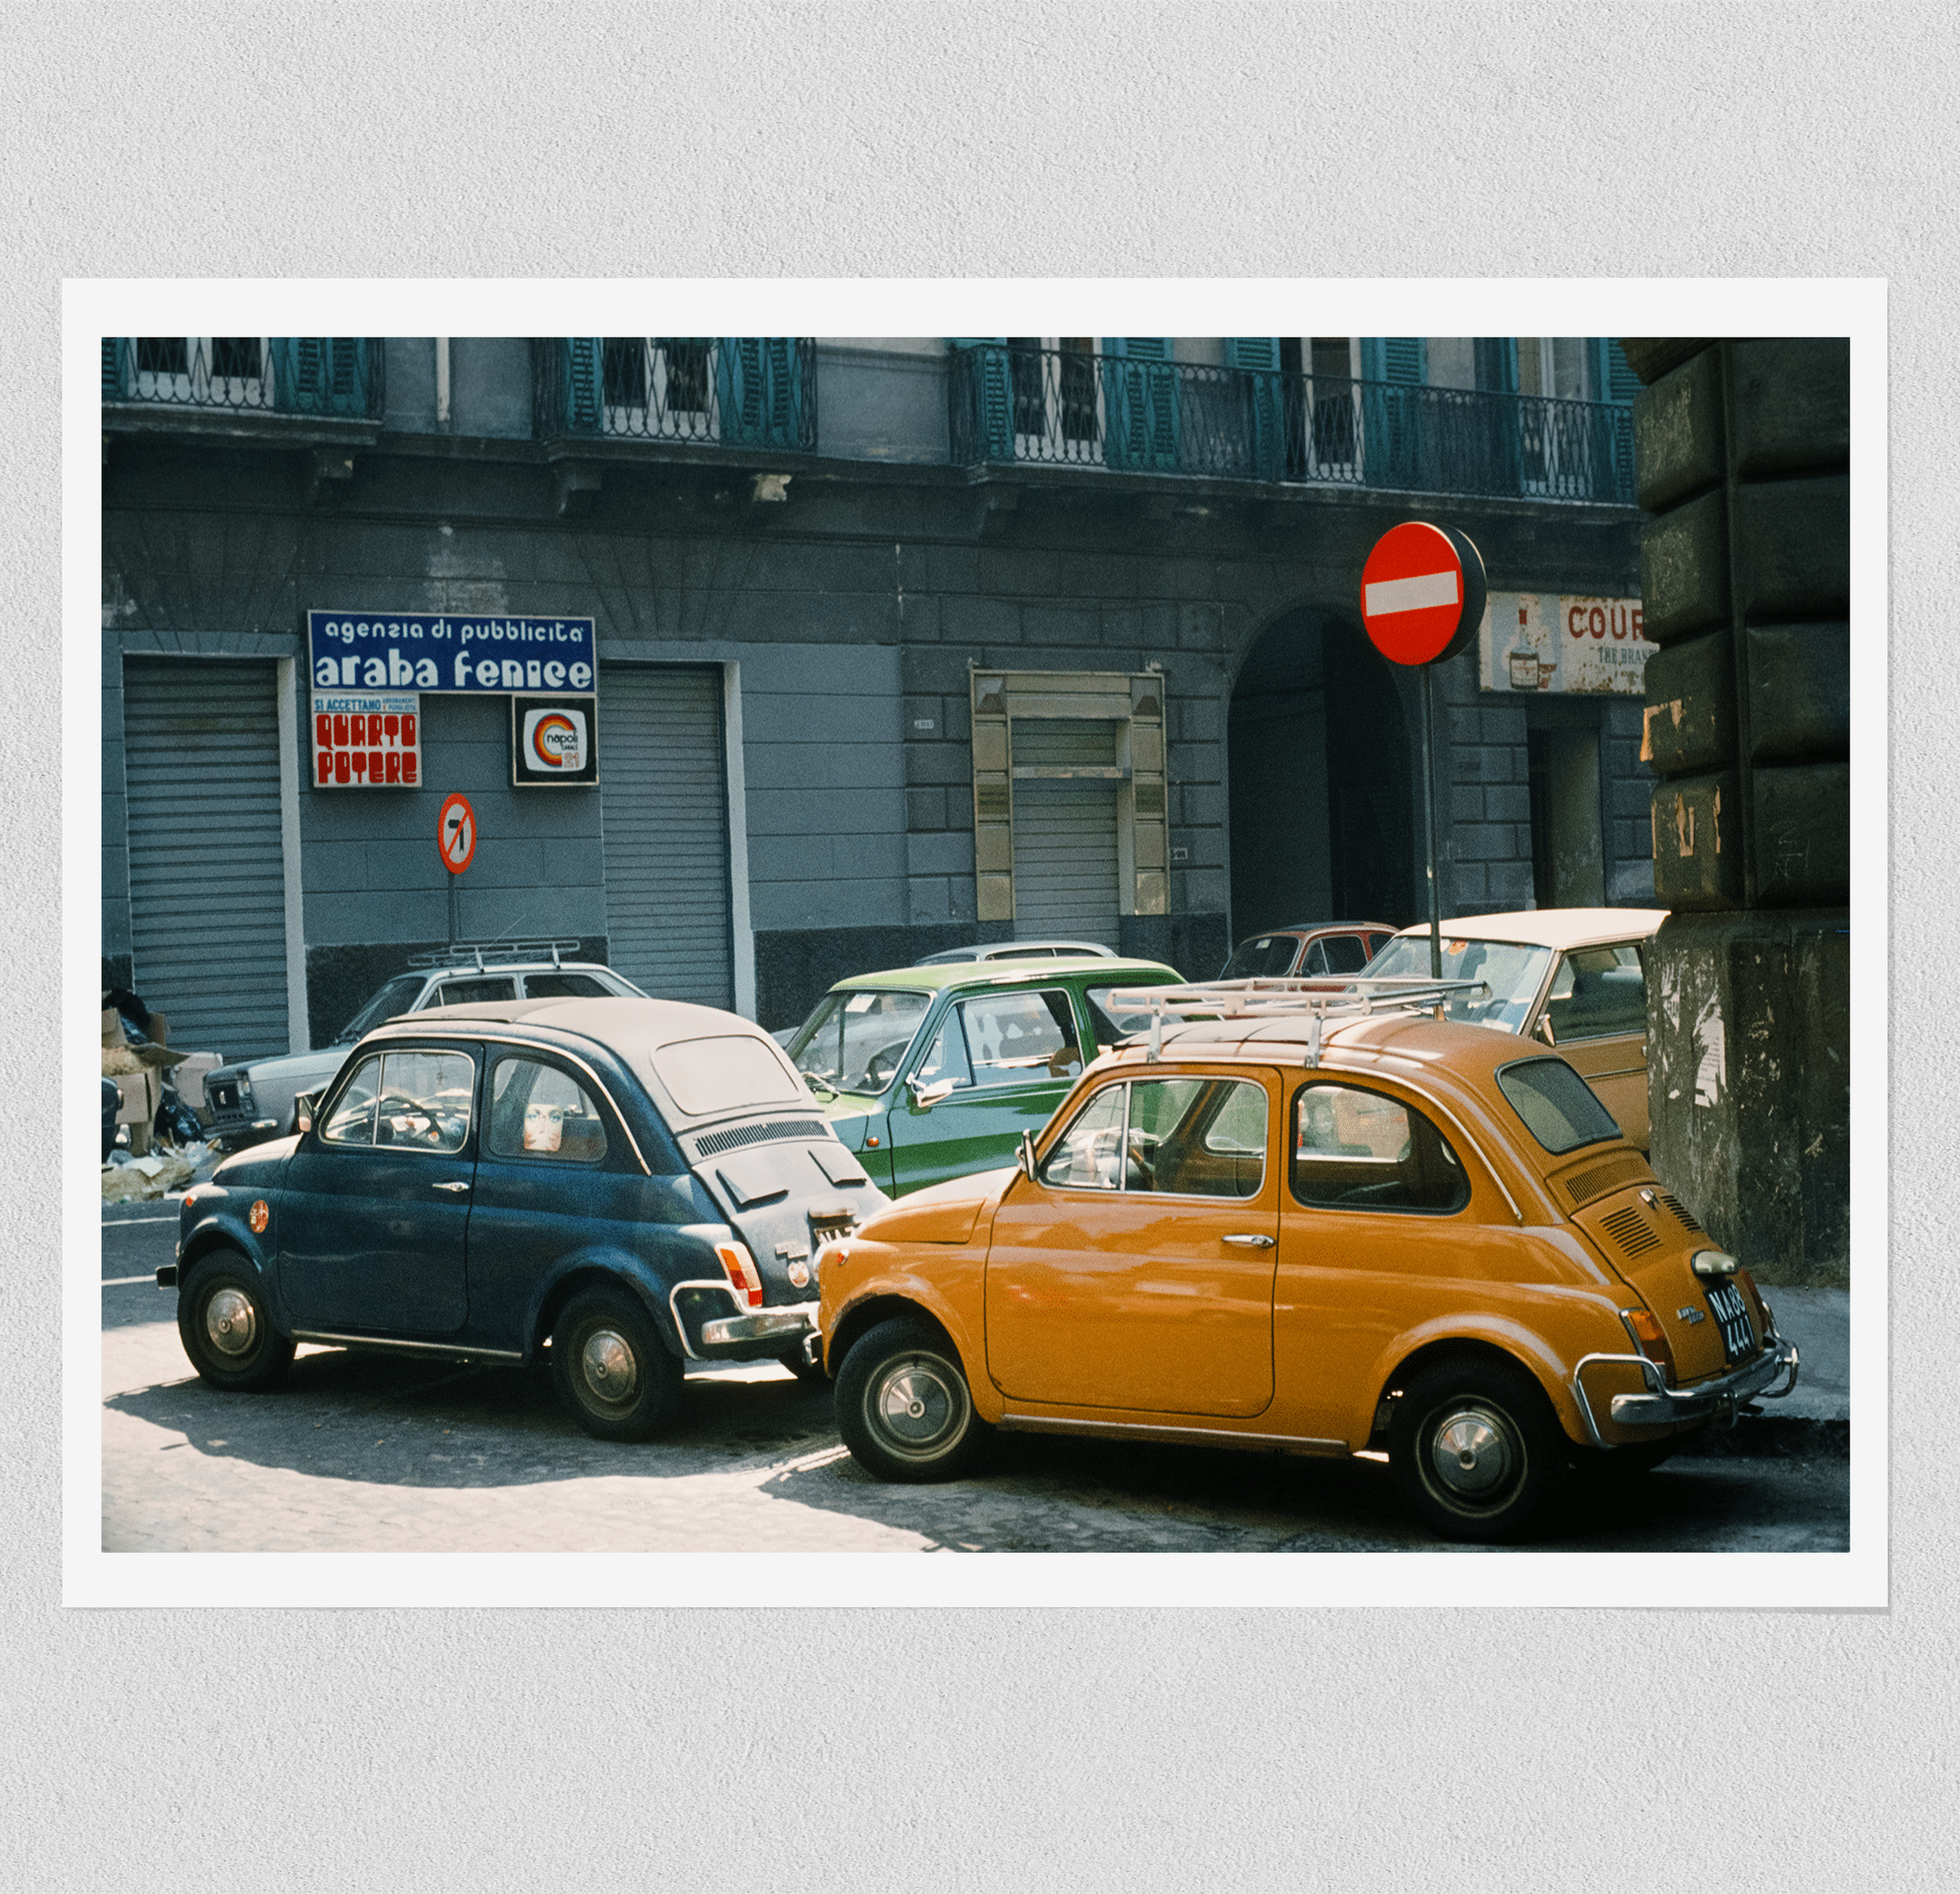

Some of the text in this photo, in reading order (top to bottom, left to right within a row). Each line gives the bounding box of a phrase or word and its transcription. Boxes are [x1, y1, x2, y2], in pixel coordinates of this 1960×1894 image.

[325, 621, 424, 644] agenzia
[431, 618, 452, 639] di
[315, 648, 592, 689] araba fenice
[314, 699, 324, 711] SI
[326, 699, 381, 711] ACCETTANO
[316, 714, 417, 750] QUARTO
[546, 730, 579, 747] napoli
[317, 751, 418, 784] POTERE
